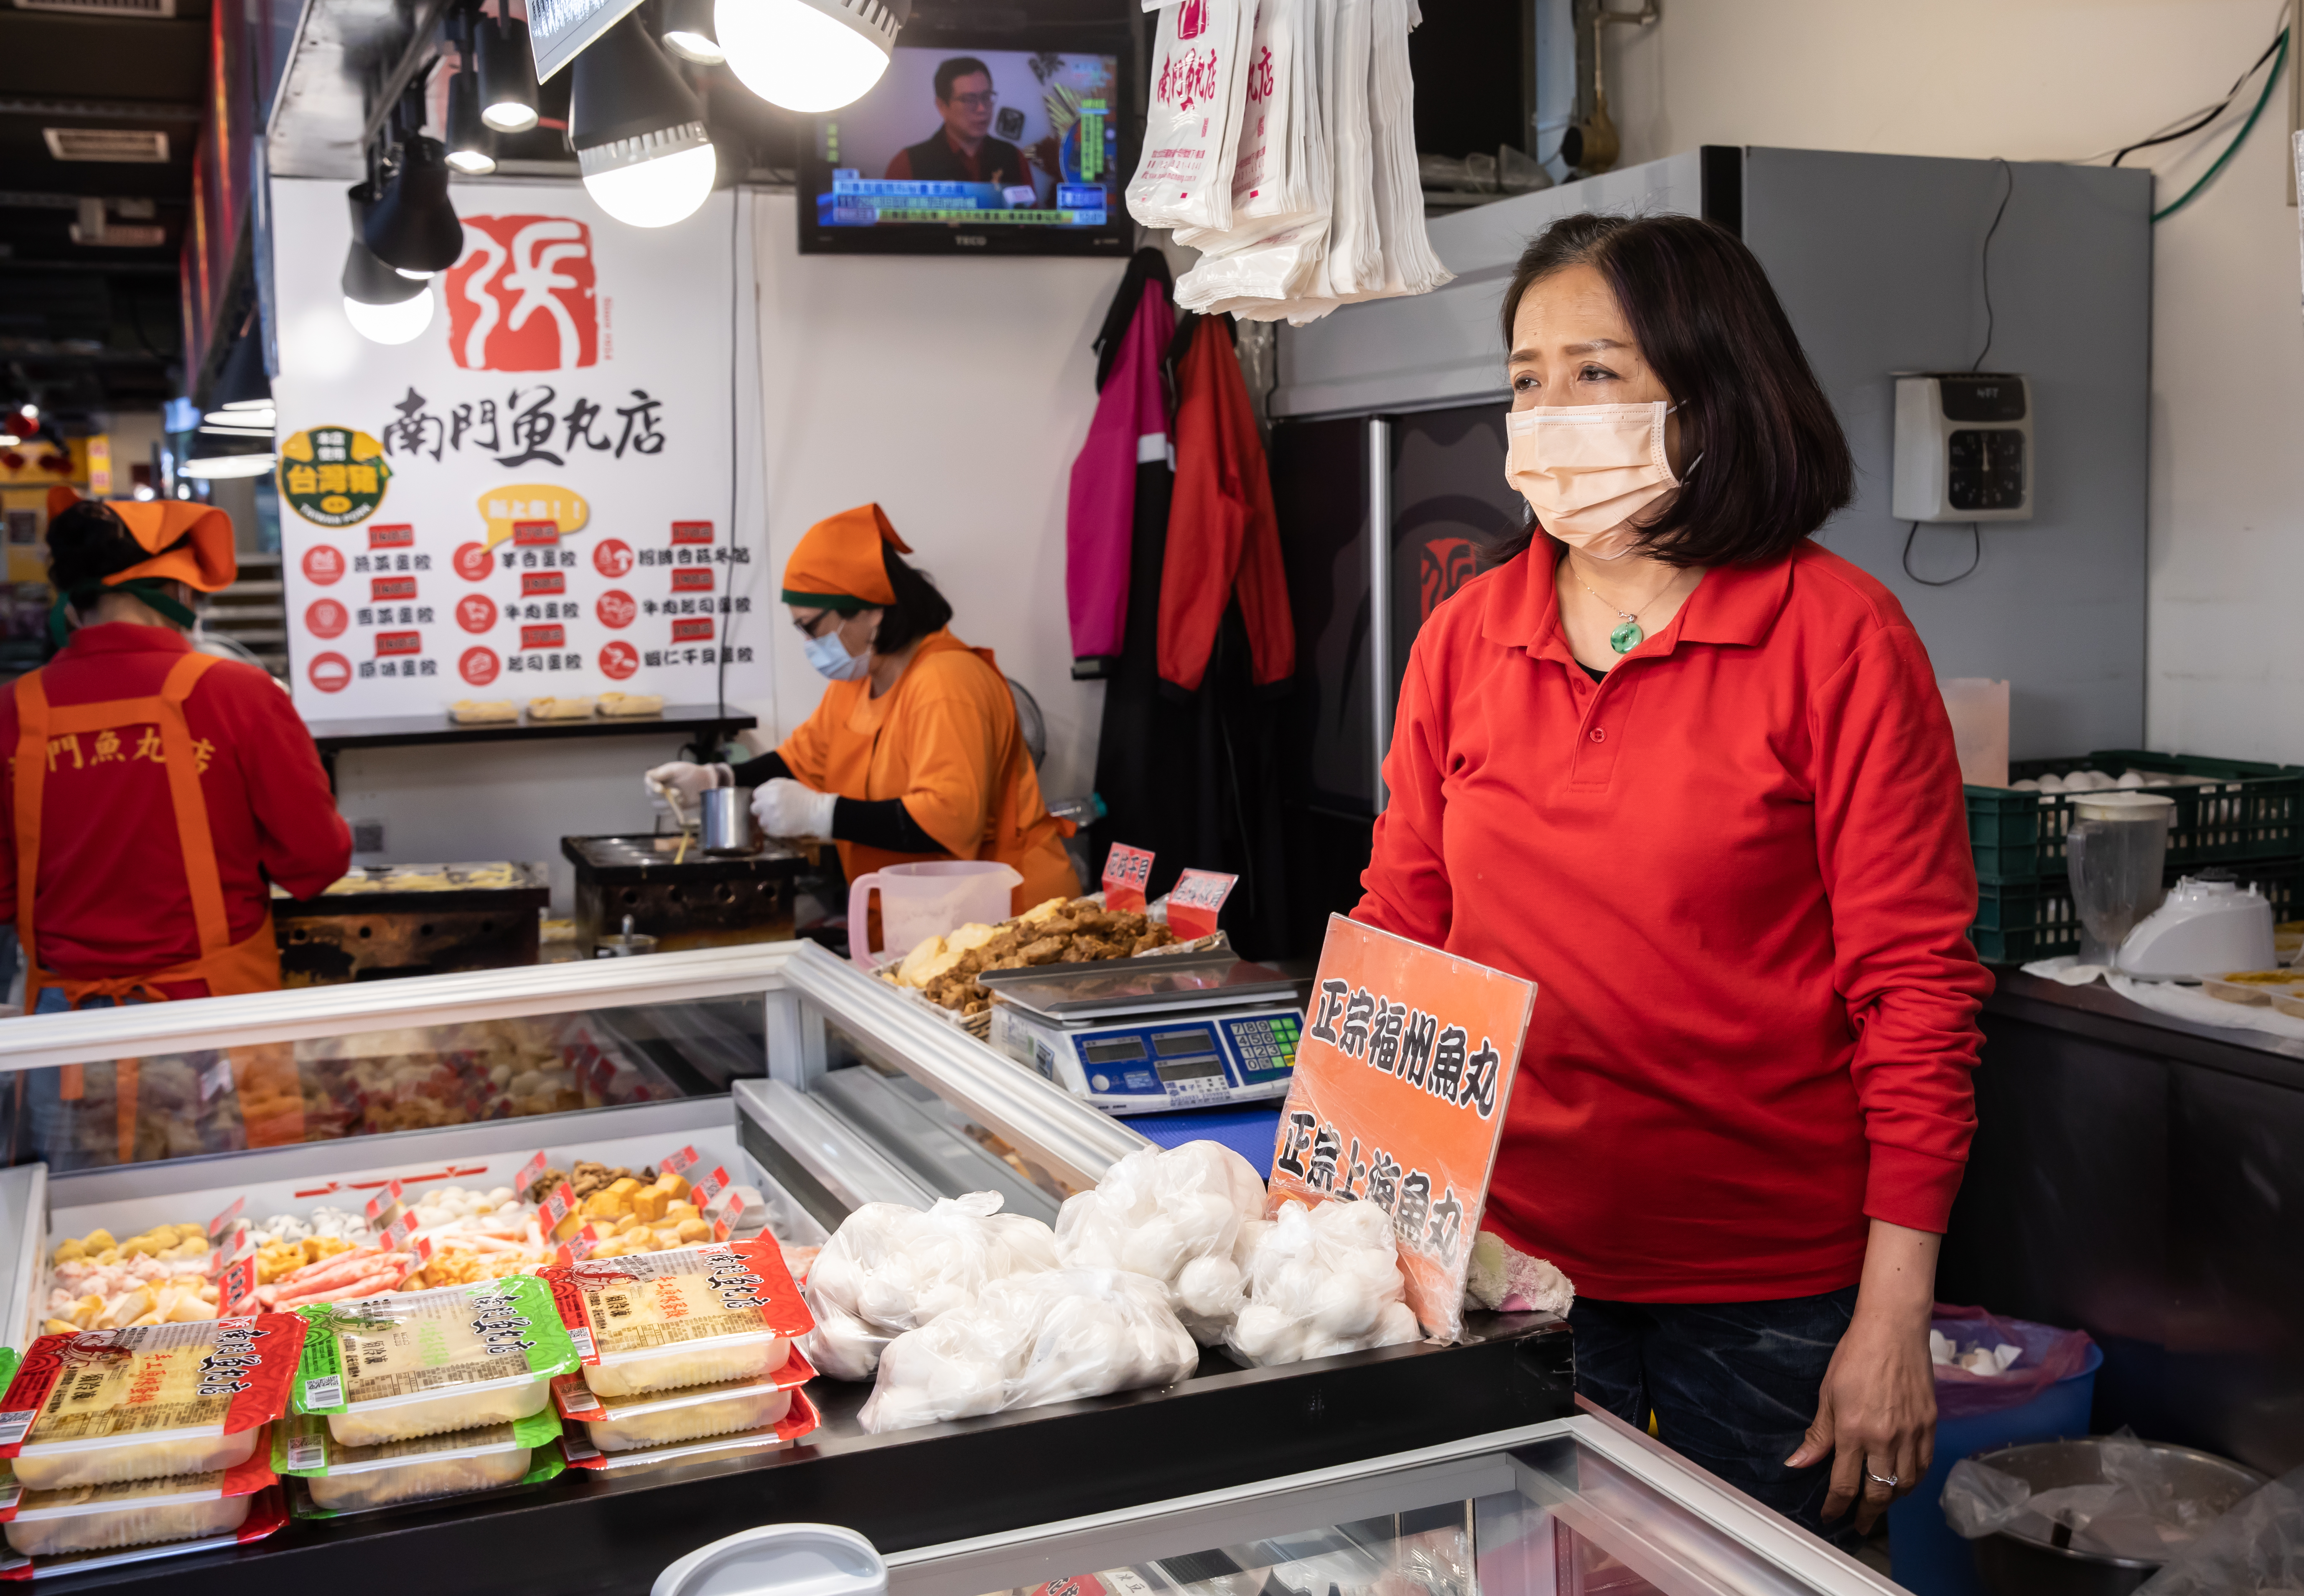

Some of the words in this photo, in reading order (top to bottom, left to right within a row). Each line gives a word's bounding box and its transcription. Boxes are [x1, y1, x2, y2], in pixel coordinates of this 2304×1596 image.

[955, 235, 987, 247] TECO
[382, 386, 666, 468] 南門魚丸店
[1233, 1023, 1240, 1033] 7
[1246, 1022, 1255, 1031] 8
[1259, 1021, 1268, 1031] 9
[1239, 1036, 1247, 1045] 4
[1251, 1034, 1260, 1044] 5
[1264, 1033, 1273, 1043] 6
[1244, 1048, 1252, 1057] 1
[1255, 1046, 1266, 1056] 2
[1268, 1045, 1278, 1054] 3
[1311, 980, 1500, 1118] 正宗福州魚丸
[1247, 1059, 1257, 1069] 0
[703, 1254, 771, 1309] 南門魚丸店
[604, 1294, 632, 1318] 須冷凍
[651, 1276, 689, 1319] 手工原味蛋餃
[471, 1295, 537, 1354] 南門魚丸店
[196, 1329, 271, 1396] 南門魚丸店
[361, 1341, 388, 1365] 須冷凍
[71, 1373, 105, 1400] 須冷凍
[126, 1354, 173, 1405] 手工原味蛋餃
